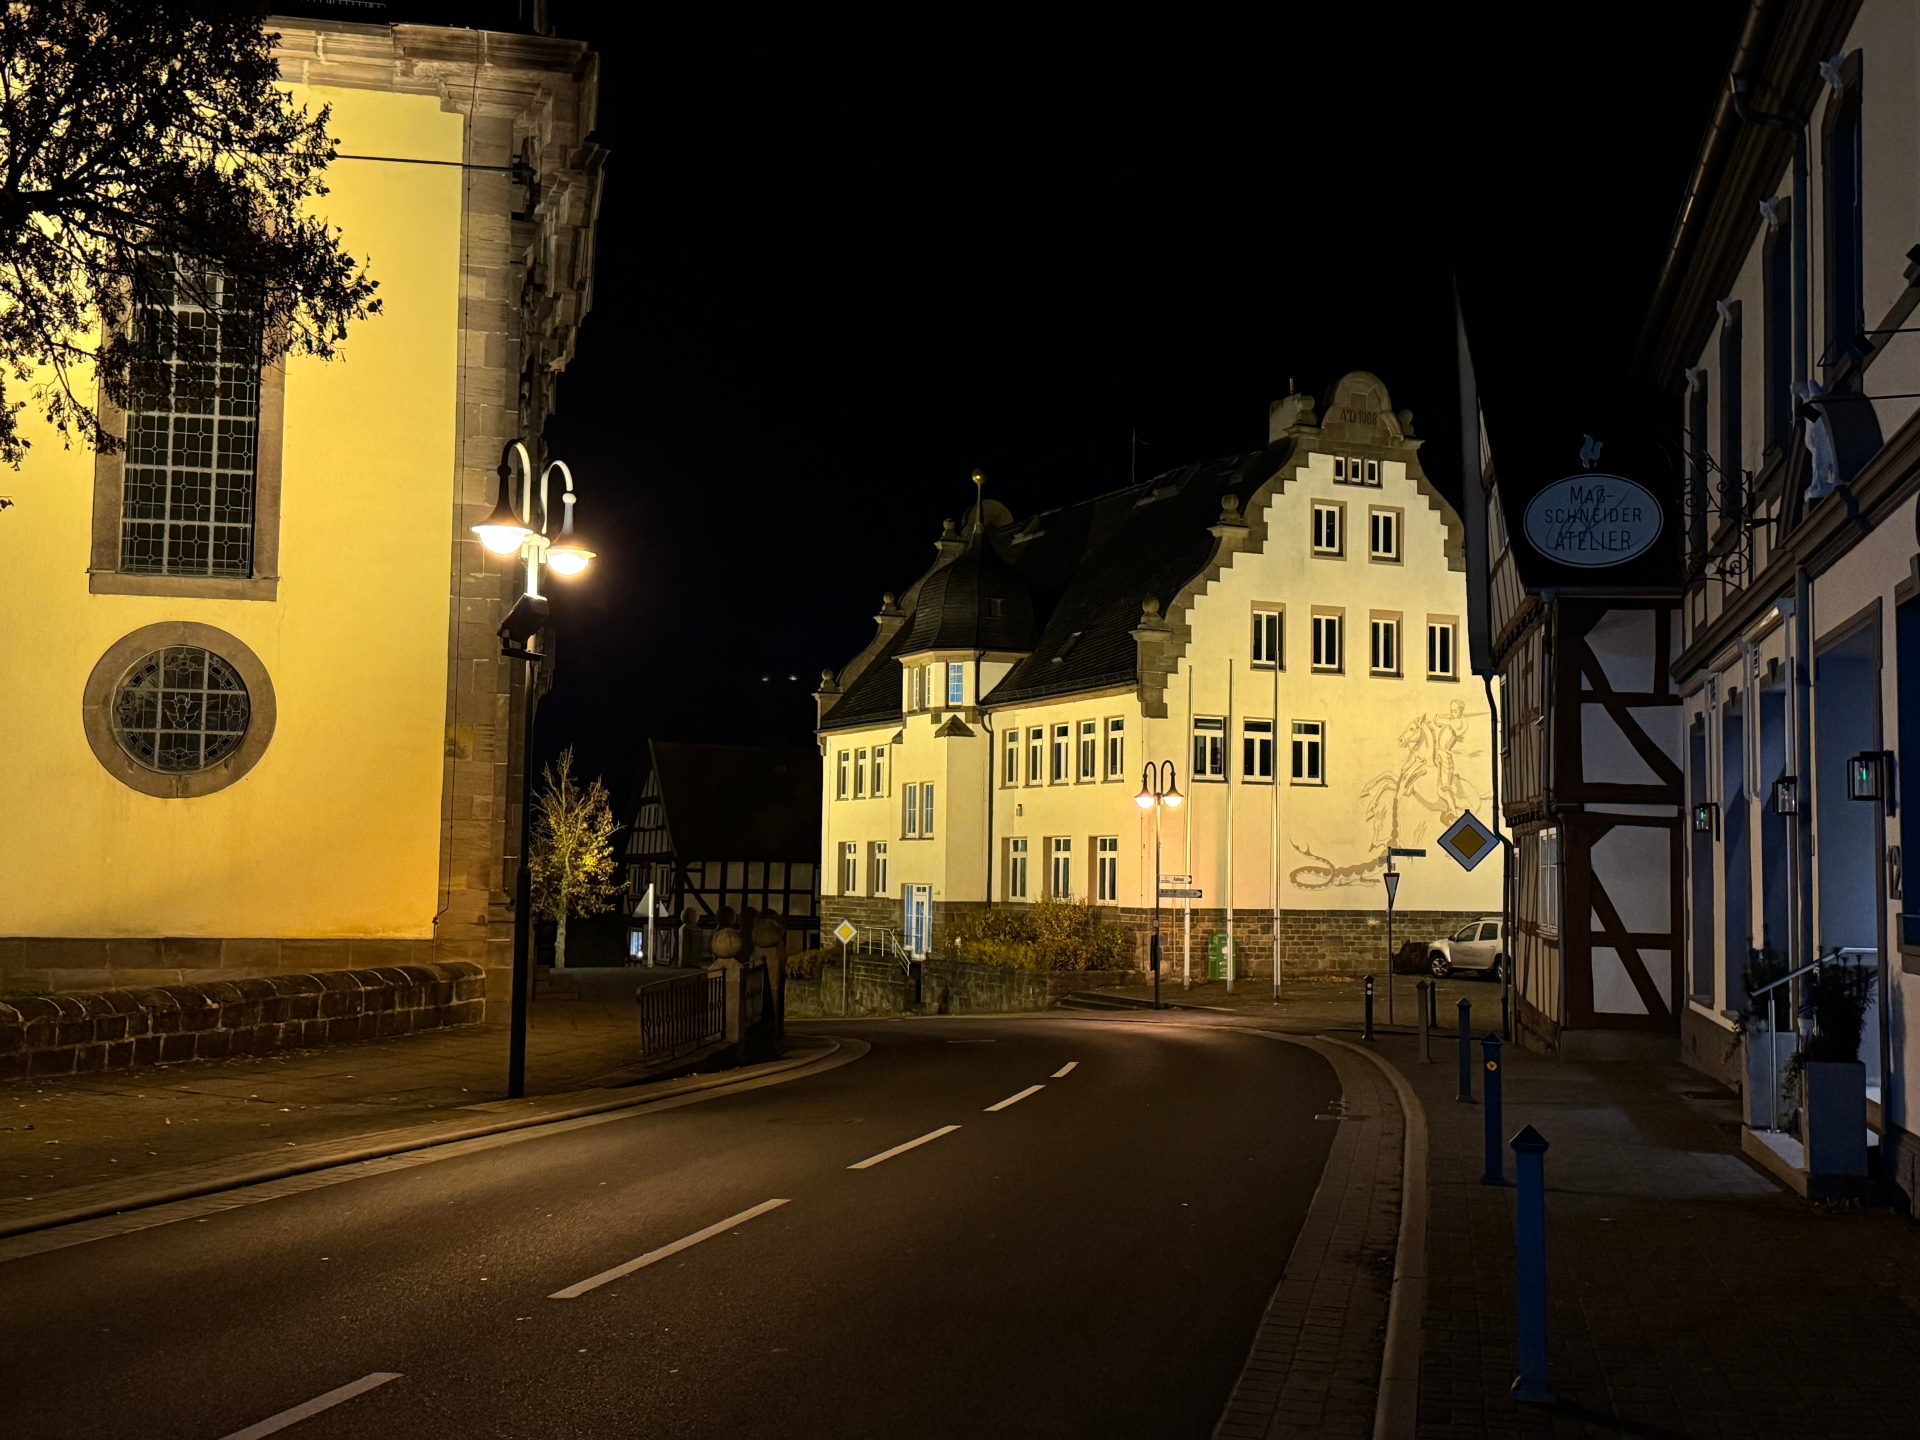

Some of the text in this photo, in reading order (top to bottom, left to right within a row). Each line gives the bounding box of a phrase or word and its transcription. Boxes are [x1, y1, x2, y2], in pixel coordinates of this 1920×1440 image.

[1359, 409, 1377, 425] 1908
[1544, 507, 1642, 524] SCHNEIDER
[1555, 530, 1631, 551] ATELIER
